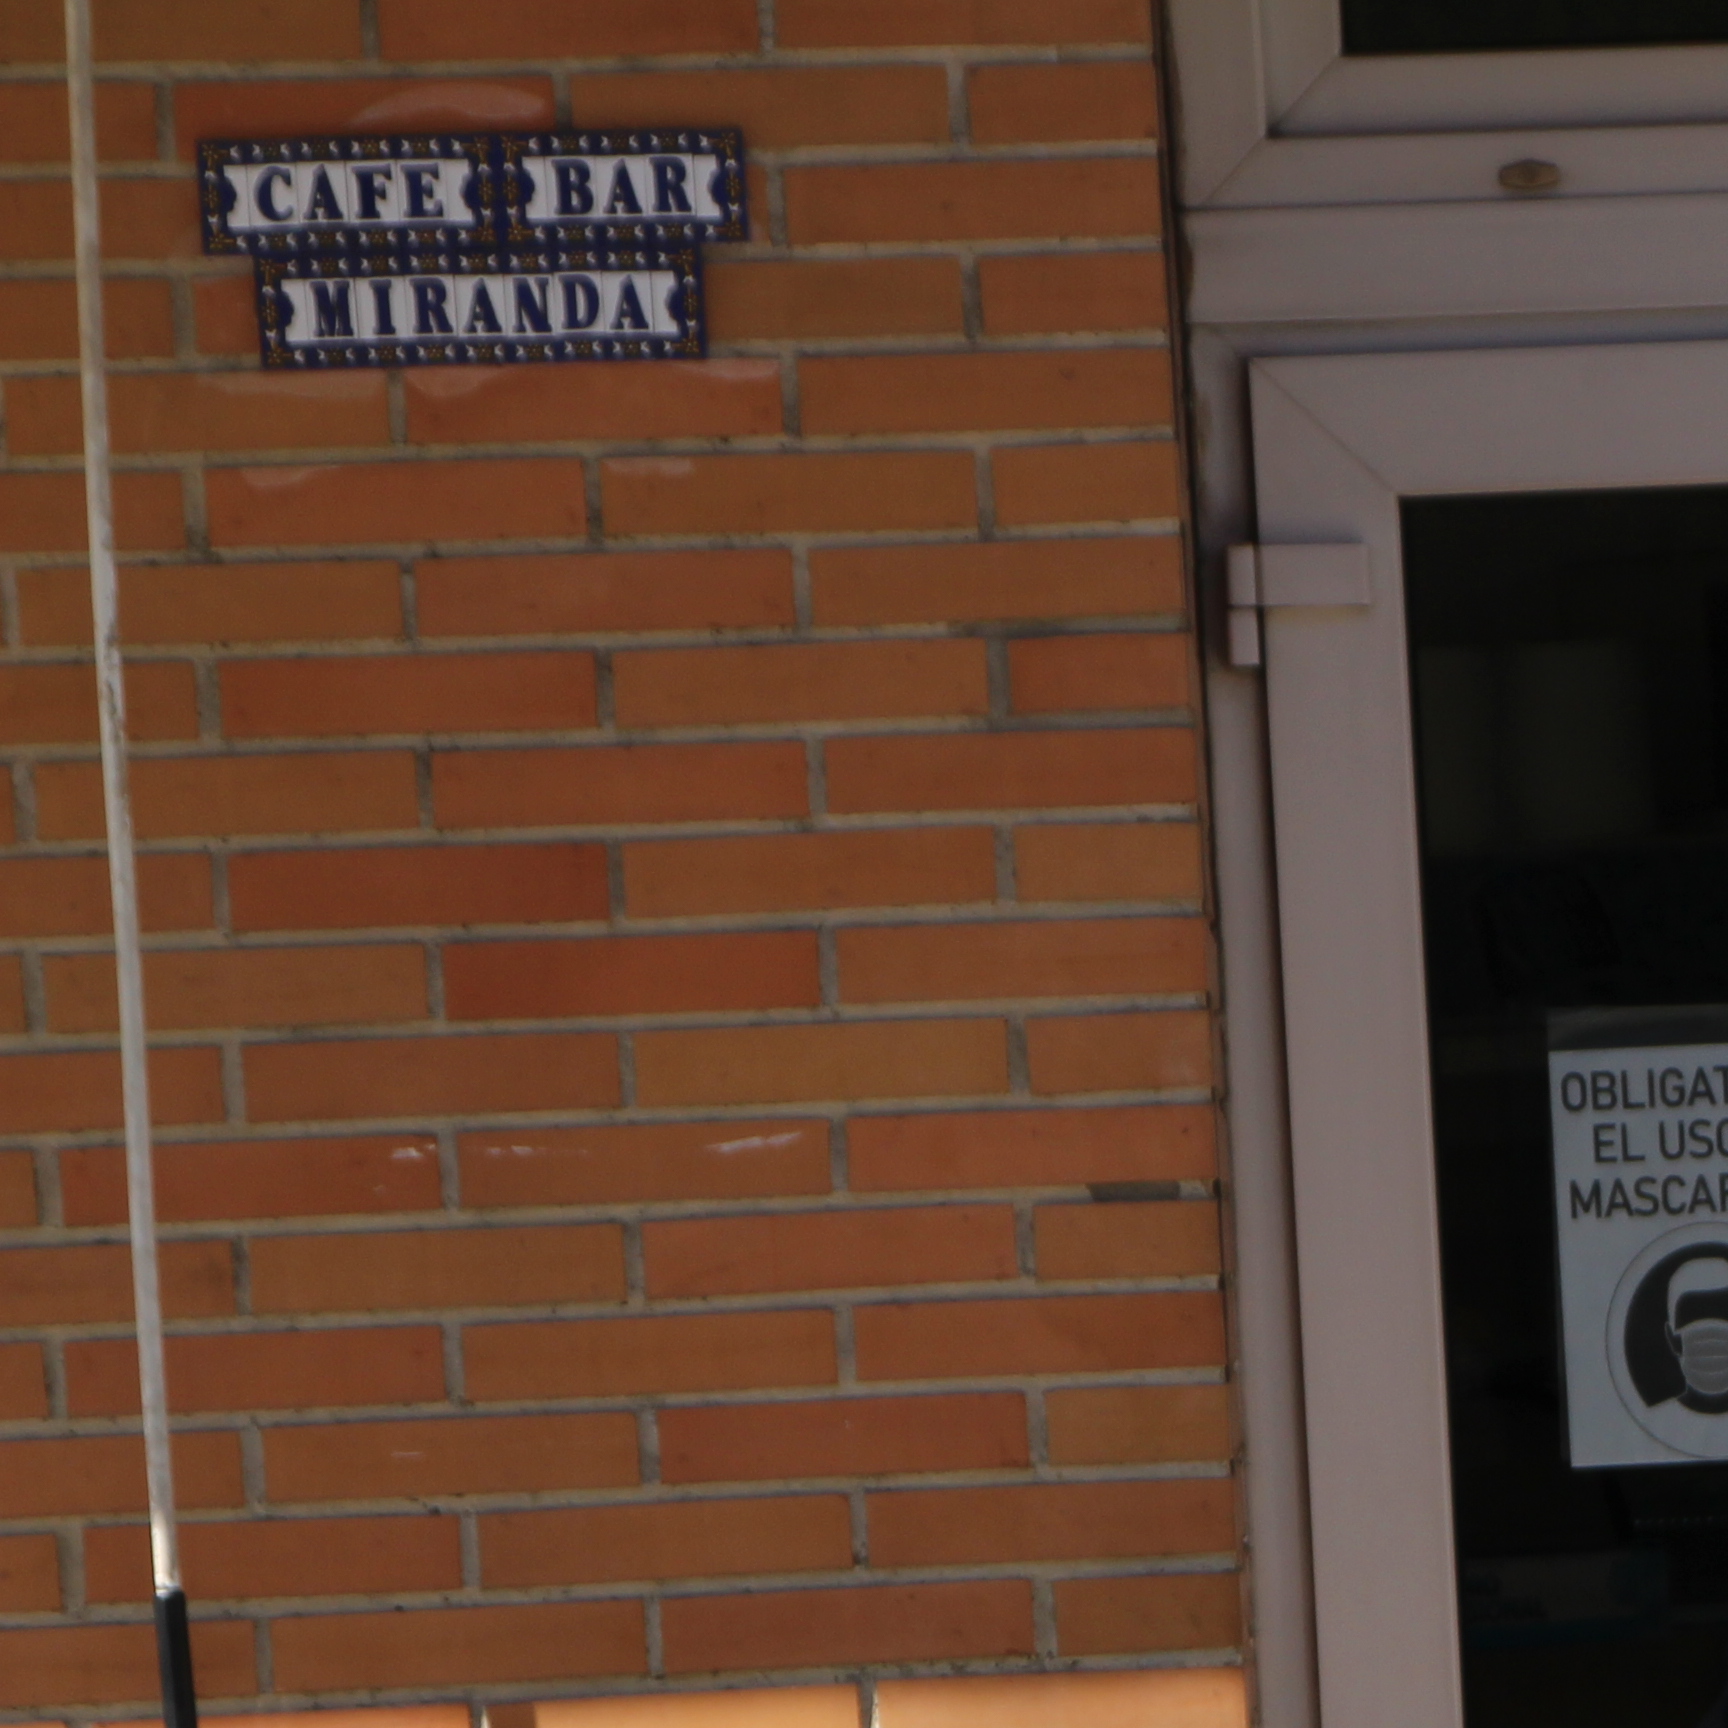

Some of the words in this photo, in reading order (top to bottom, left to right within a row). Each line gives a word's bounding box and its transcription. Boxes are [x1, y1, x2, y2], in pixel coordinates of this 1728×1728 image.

[252, 161, 445, 222] CAFE
[550, 153, 694, 217] BAR
[309, 274, 650, 338] MIRANDA
[1592, 1122, 1645, 1163] EL
